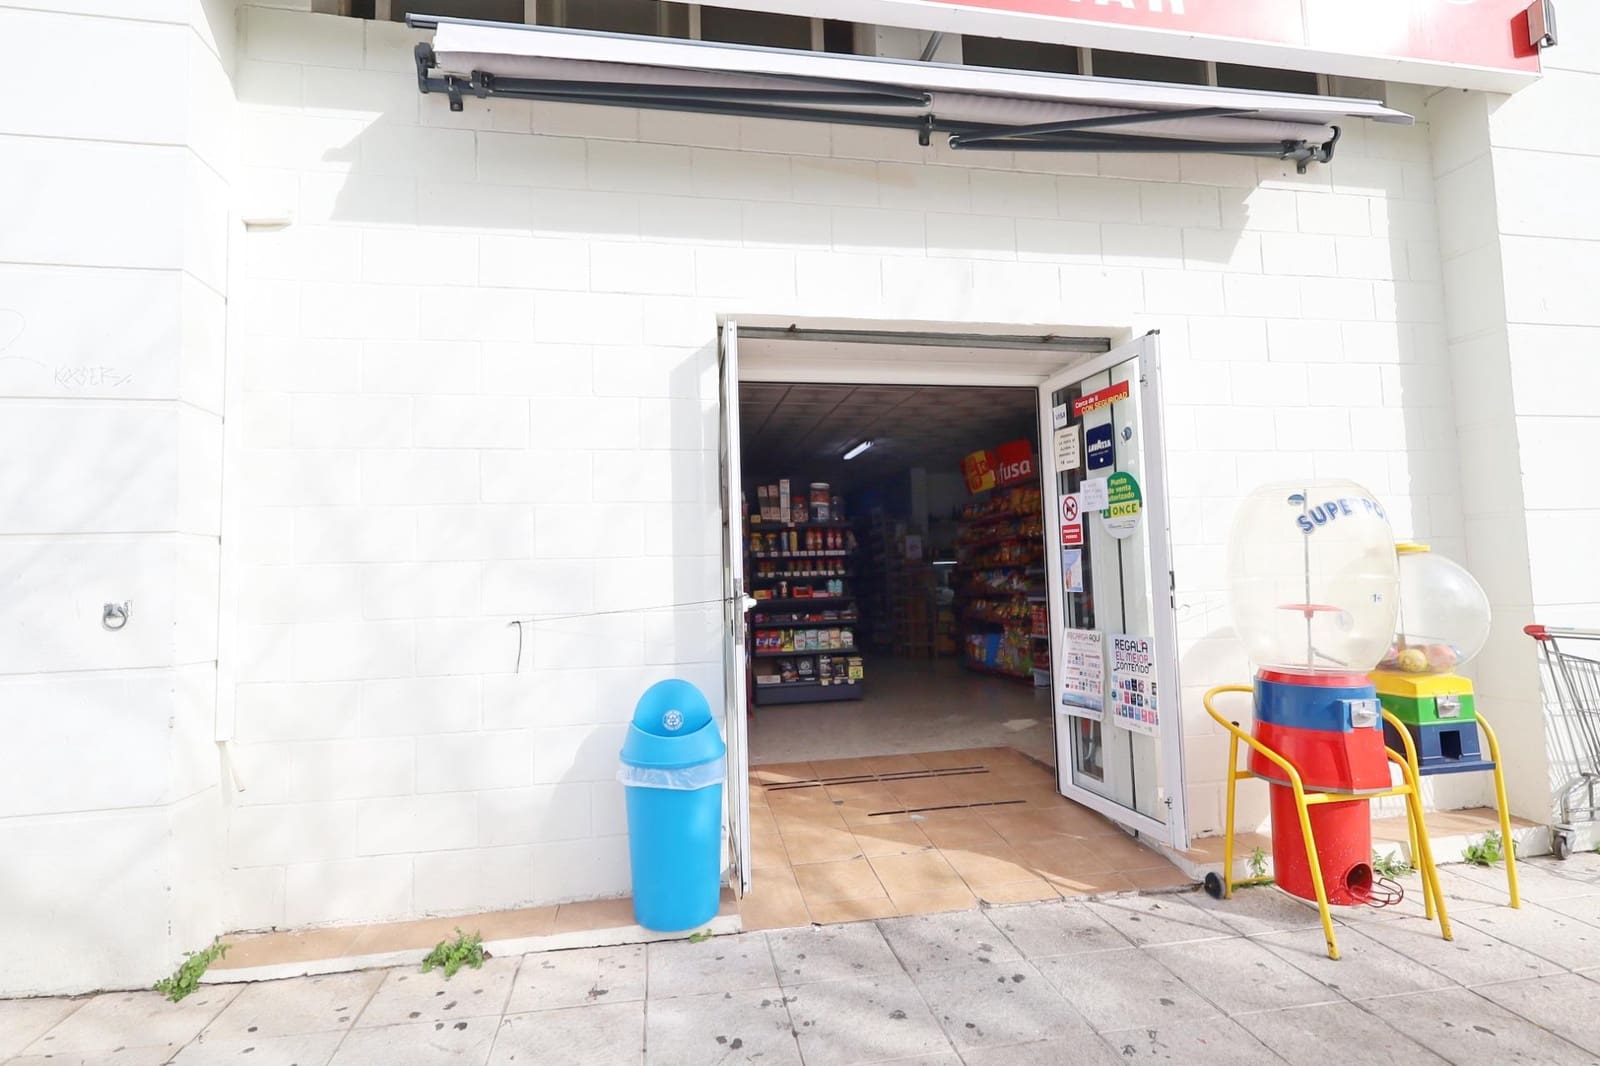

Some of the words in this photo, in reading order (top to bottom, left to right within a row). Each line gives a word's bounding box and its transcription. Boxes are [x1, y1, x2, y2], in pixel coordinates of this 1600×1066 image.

[1081, 404, 1095, 416] CON
[1095, 391, 1128, 409] SEGURIDAD
[1110, 476, 1127, 487] Punto
[1115, 483, 1132, 494] venta
[1112, 502, 1138, 516] ONCE
[1114, 639, 1148, 653] REGALA
[1115, 651, 1125, 661] EL
[1126, 652, 1149, 664] MEJOR
[1115, 661, 1150, 674] CONTENIDO
